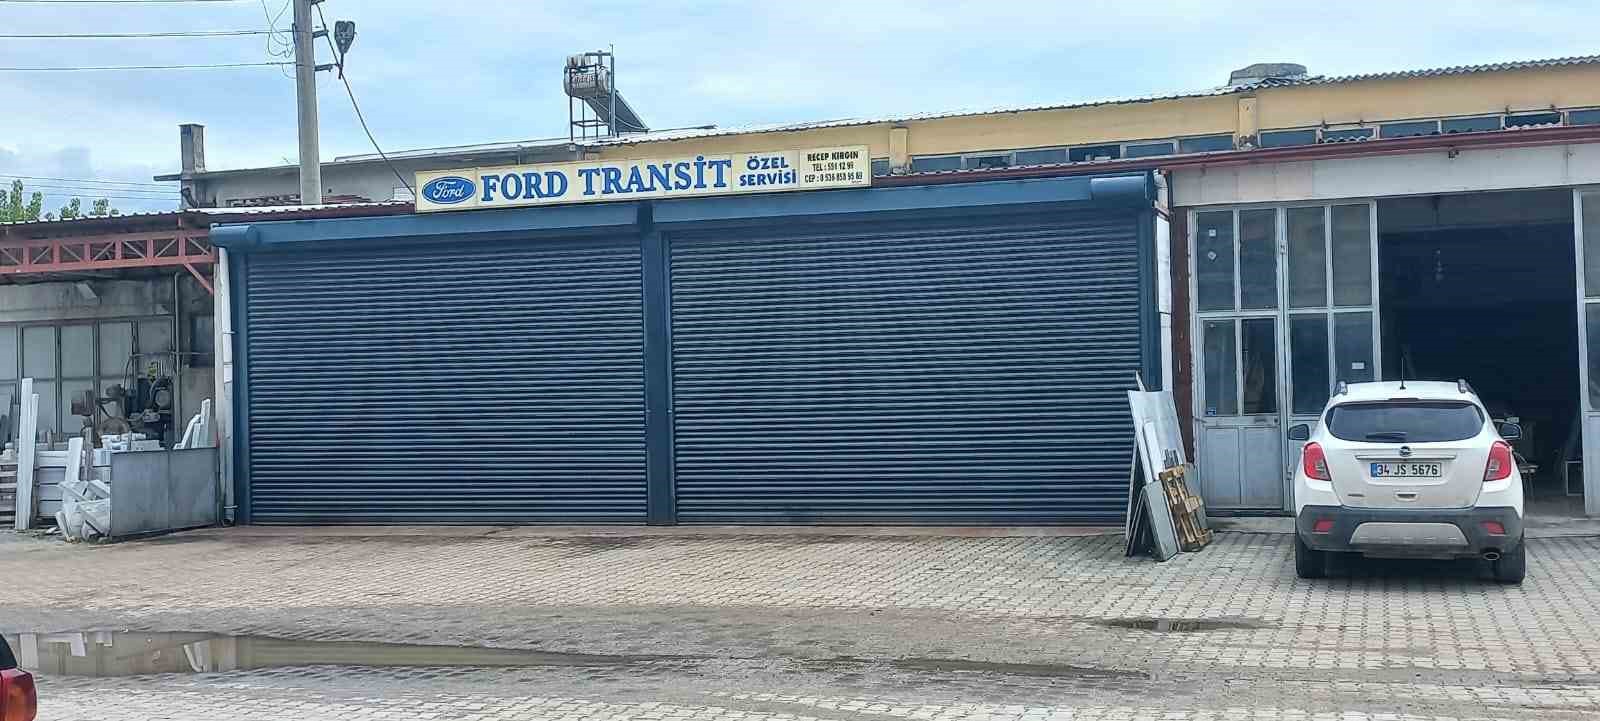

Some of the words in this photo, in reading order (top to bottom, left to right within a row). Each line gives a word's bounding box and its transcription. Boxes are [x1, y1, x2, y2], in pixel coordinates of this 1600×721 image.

[747, 155, 789, 170] ÖZEL
[807, 152, 830, 162] RECEP
[812, 163, 823, 172] TEL
[481, 171, 568, 202] FORD
[578, 155, 732, 196] TRANSİT
[739, 169, 797, 186] SERVİSİ
[804, 174, 816, 183] CEP
[432, 180, 465, 199] Ford
[1377, 464, 1390, 475] 34
[1394, 464, 1407, 475] JS
[1411, 464, 1438, 475] 5676
